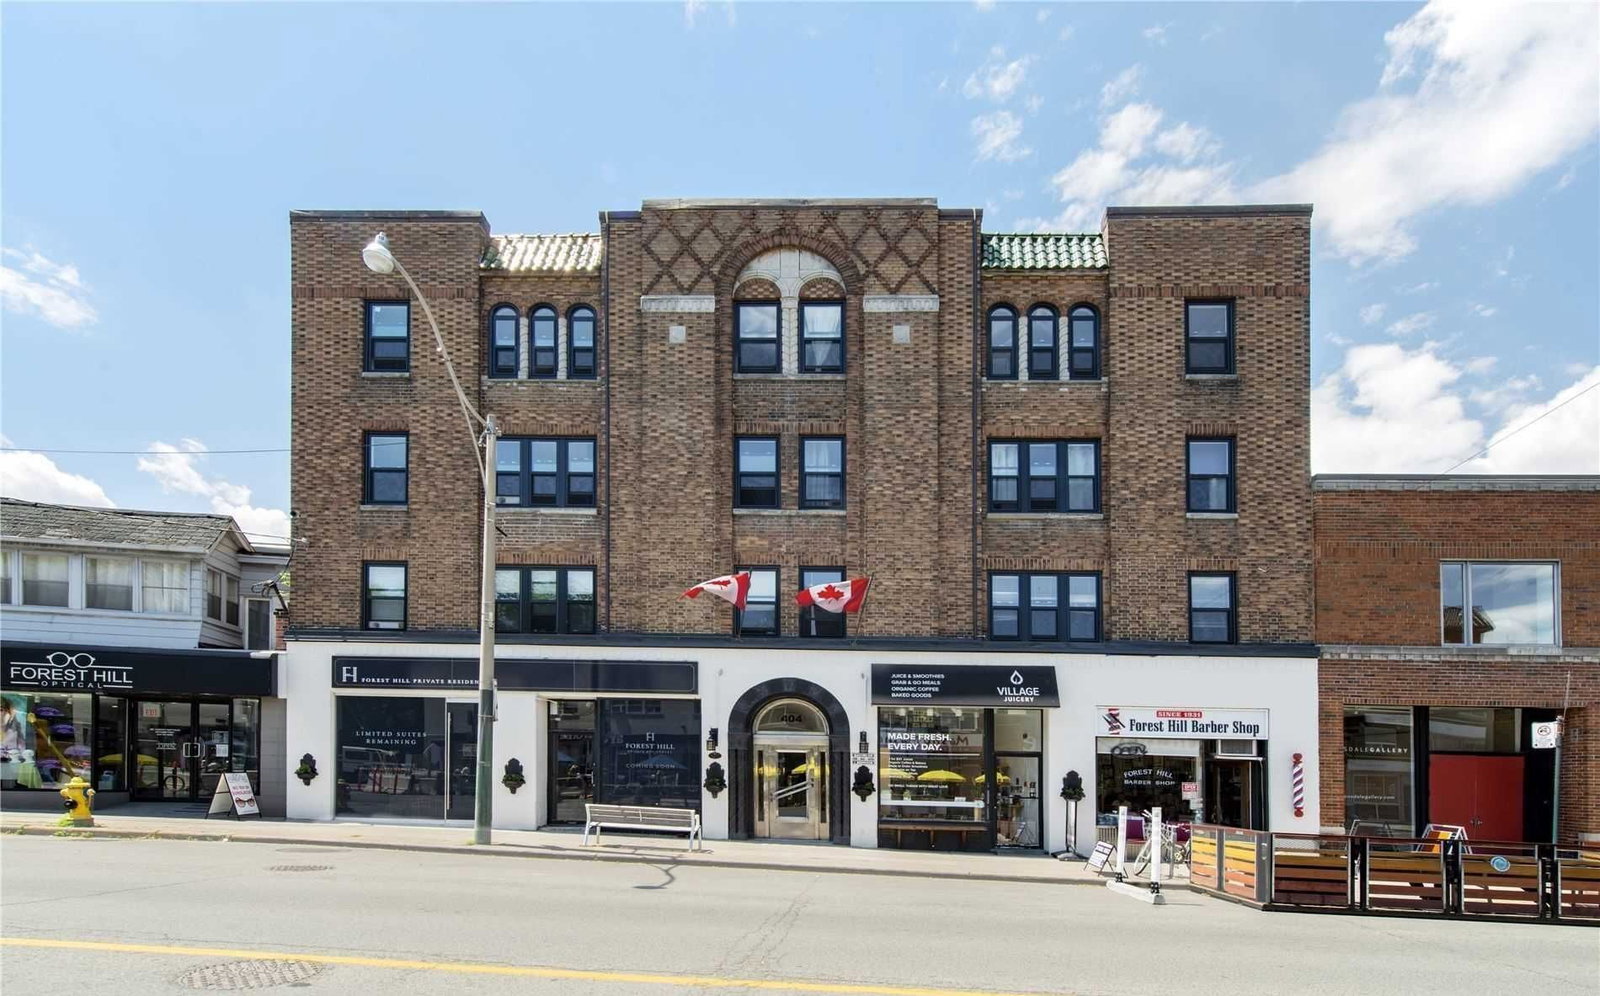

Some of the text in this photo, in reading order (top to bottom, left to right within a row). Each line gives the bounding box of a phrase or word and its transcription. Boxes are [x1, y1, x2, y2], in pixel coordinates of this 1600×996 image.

[10, 667, 133, 683] FOREST HILL
[40, 680, 103, 688] OPTICAL
[996, 686, 1040, 696] VILLAGE
[780, 714, 802, 722] 404
[1129, 718, 1260, 737] Forest Hill Barber Shop
[887, 732, 952, 741] MADE FRESH.
[1124, 768, 1173, 779] FOREST HILL
